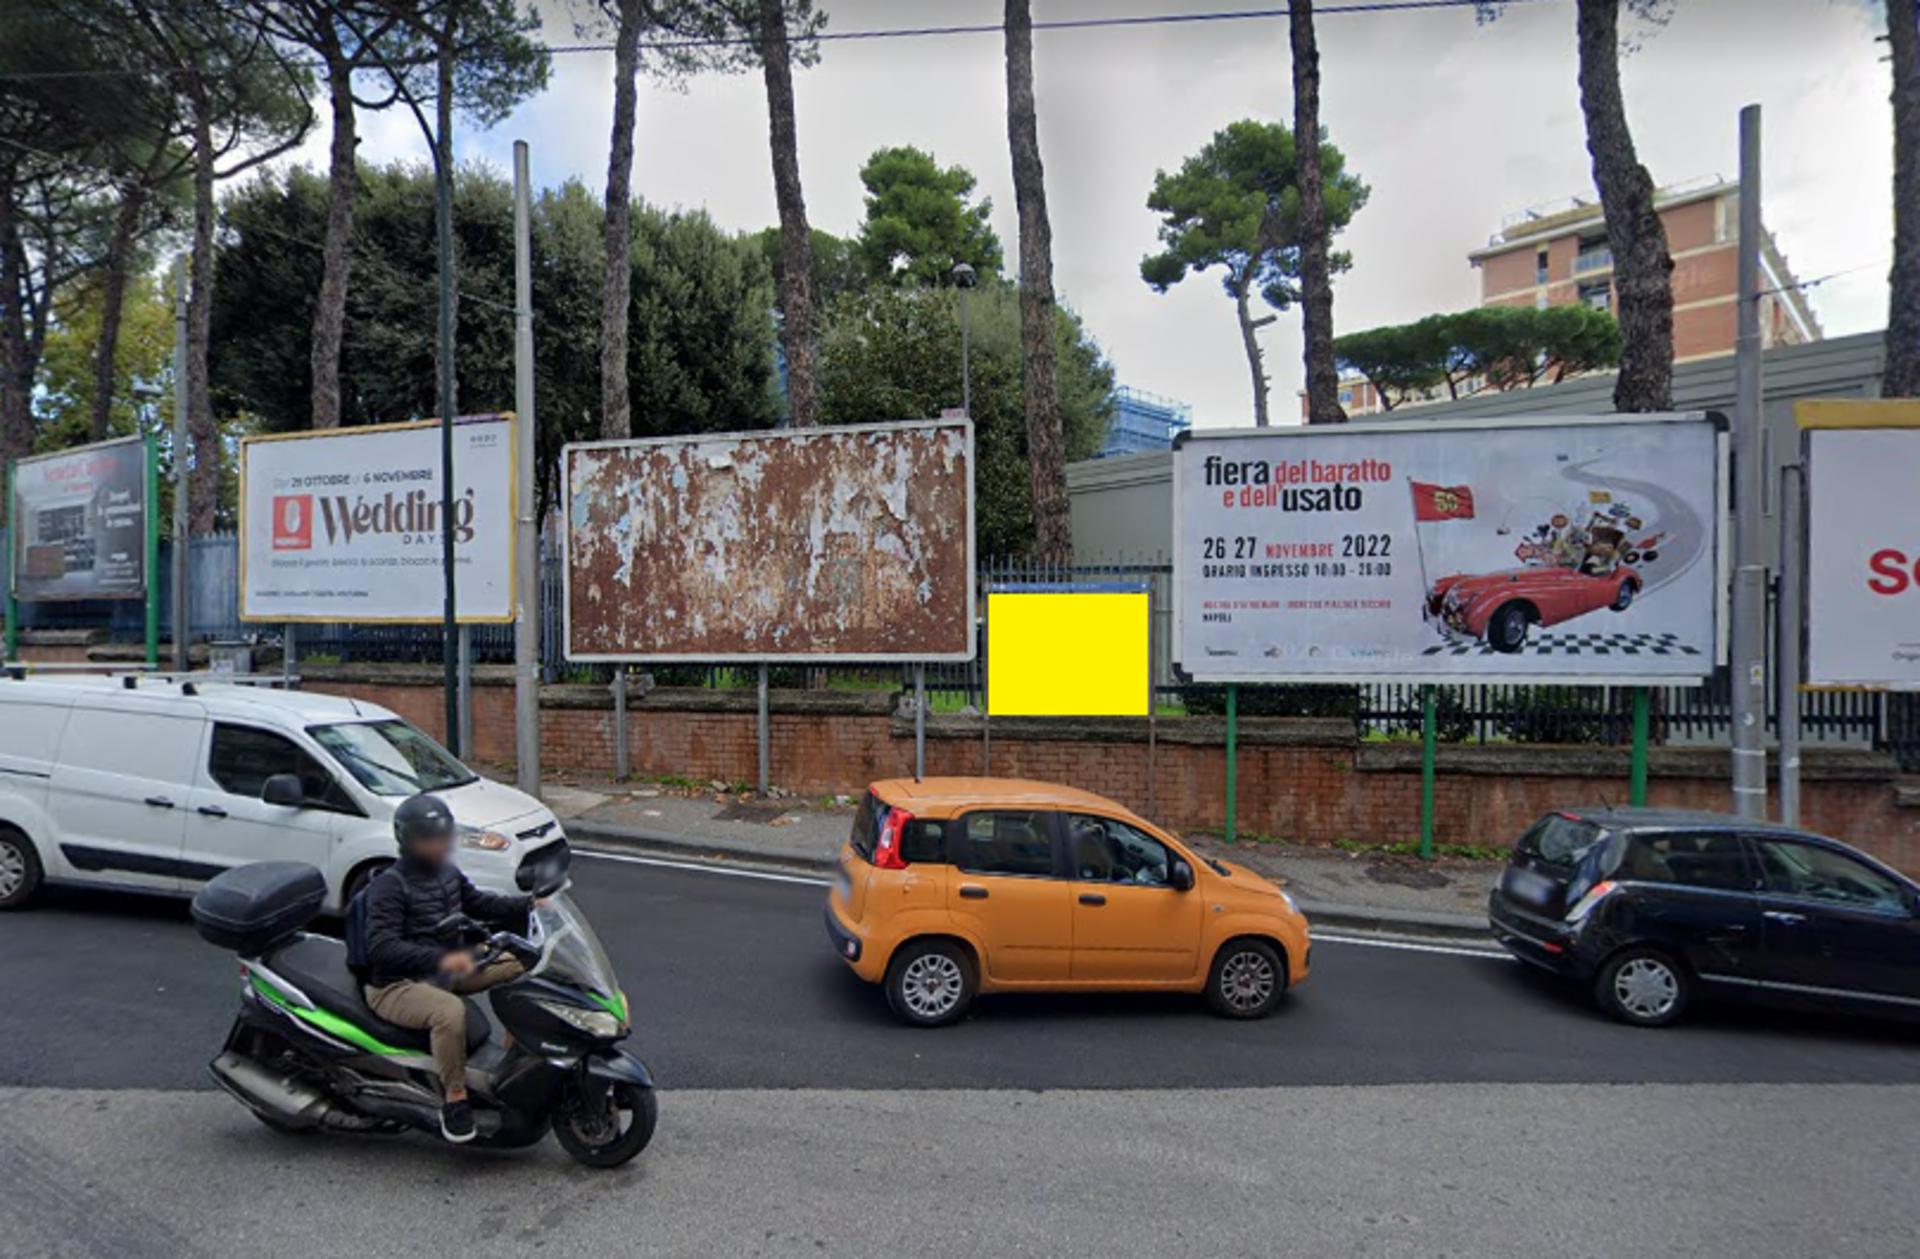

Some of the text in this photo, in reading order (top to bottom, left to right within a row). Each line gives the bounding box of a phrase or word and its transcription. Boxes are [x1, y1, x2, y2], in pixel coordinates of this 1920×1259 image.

[304, 474, 350, 487] OTTOBRE
[373, 469, 433, 483] NOVEMBRE
[1204, 456, 1391, 485] fiera del baratto
[1223, 490, 1234, 507] e
[1204, 534, 1391, 559] 26 27 NOVEMBRE 2022
